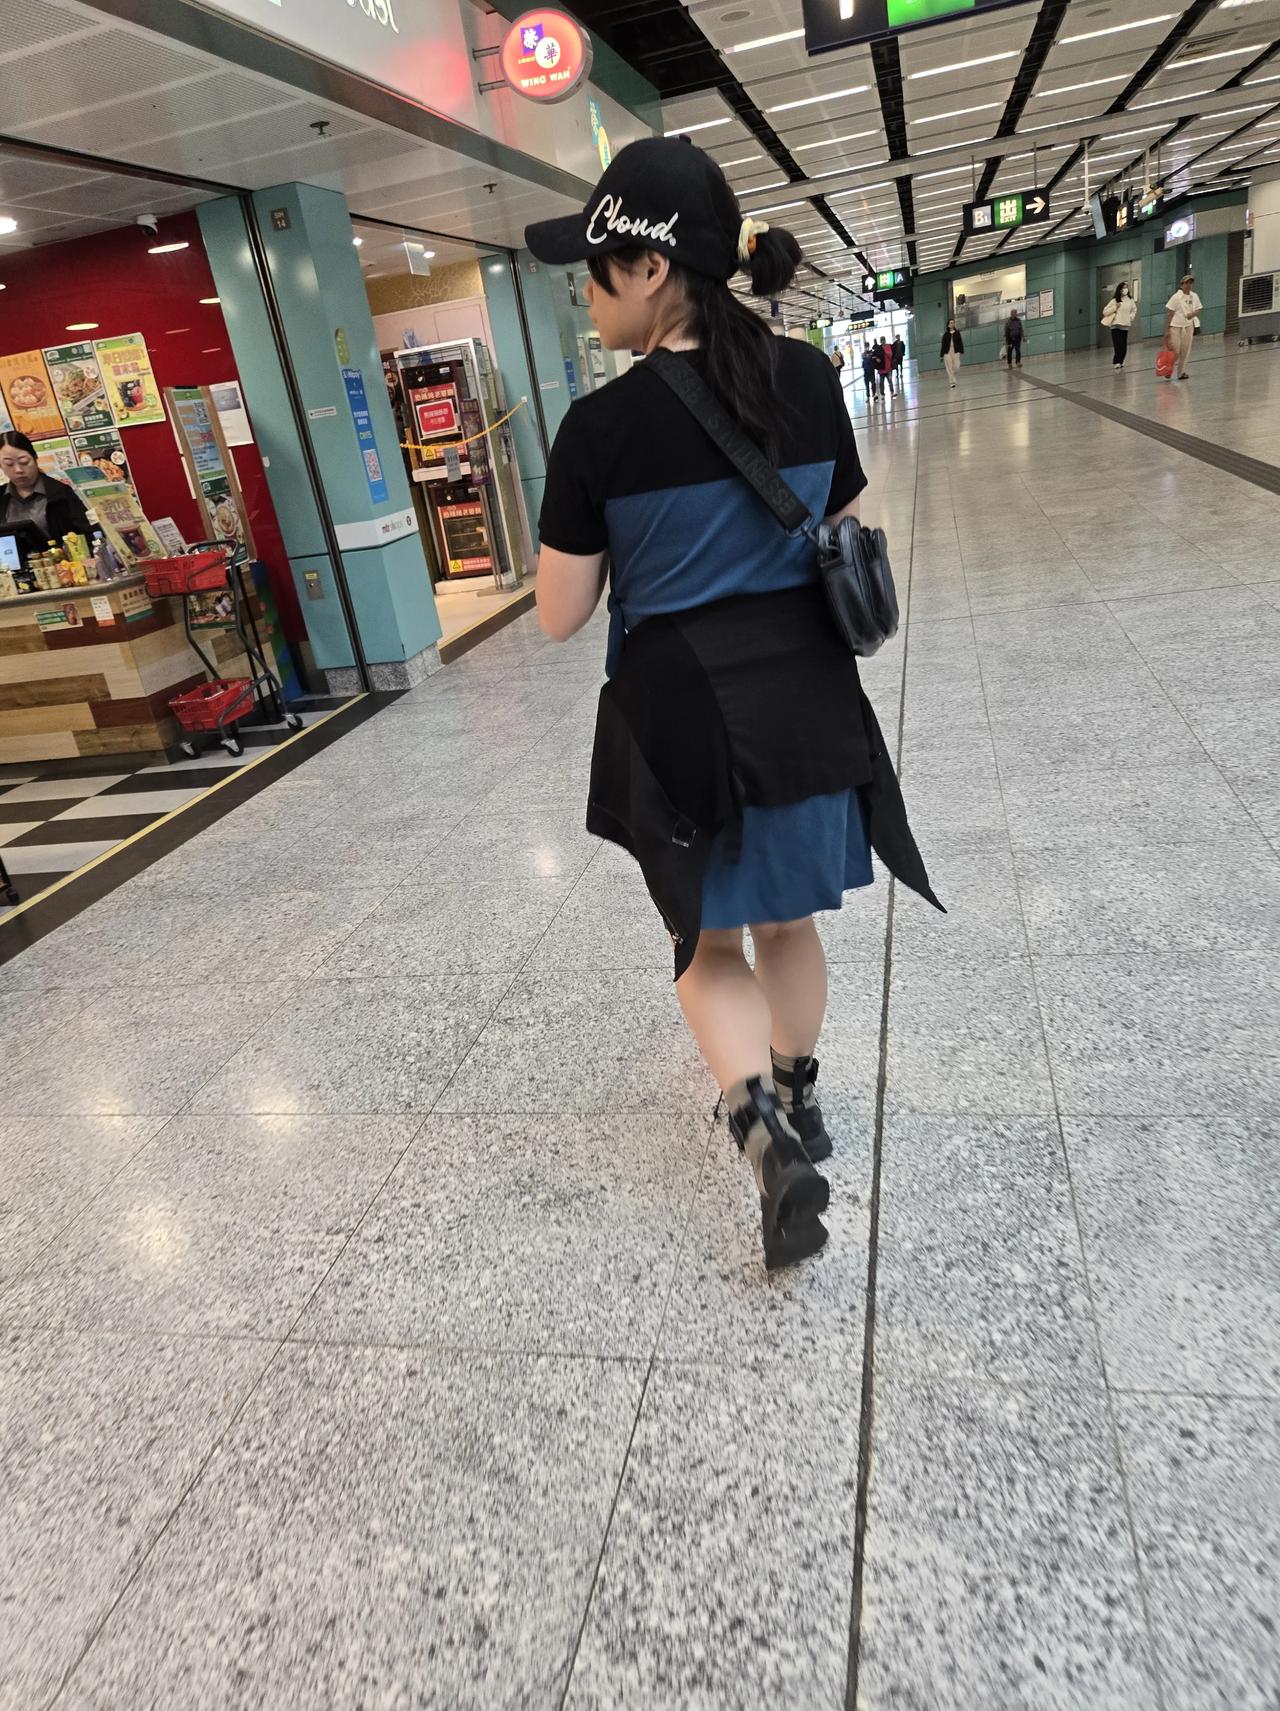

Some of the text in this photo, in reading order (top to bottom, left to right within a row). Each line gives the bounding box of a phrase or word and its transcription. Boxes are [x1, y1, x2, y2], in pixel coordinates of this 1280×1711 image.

[521, 75, 547, 89] WING
[1000, 199, 1017, 216] 出
[974, 210, 988, 226] B1
